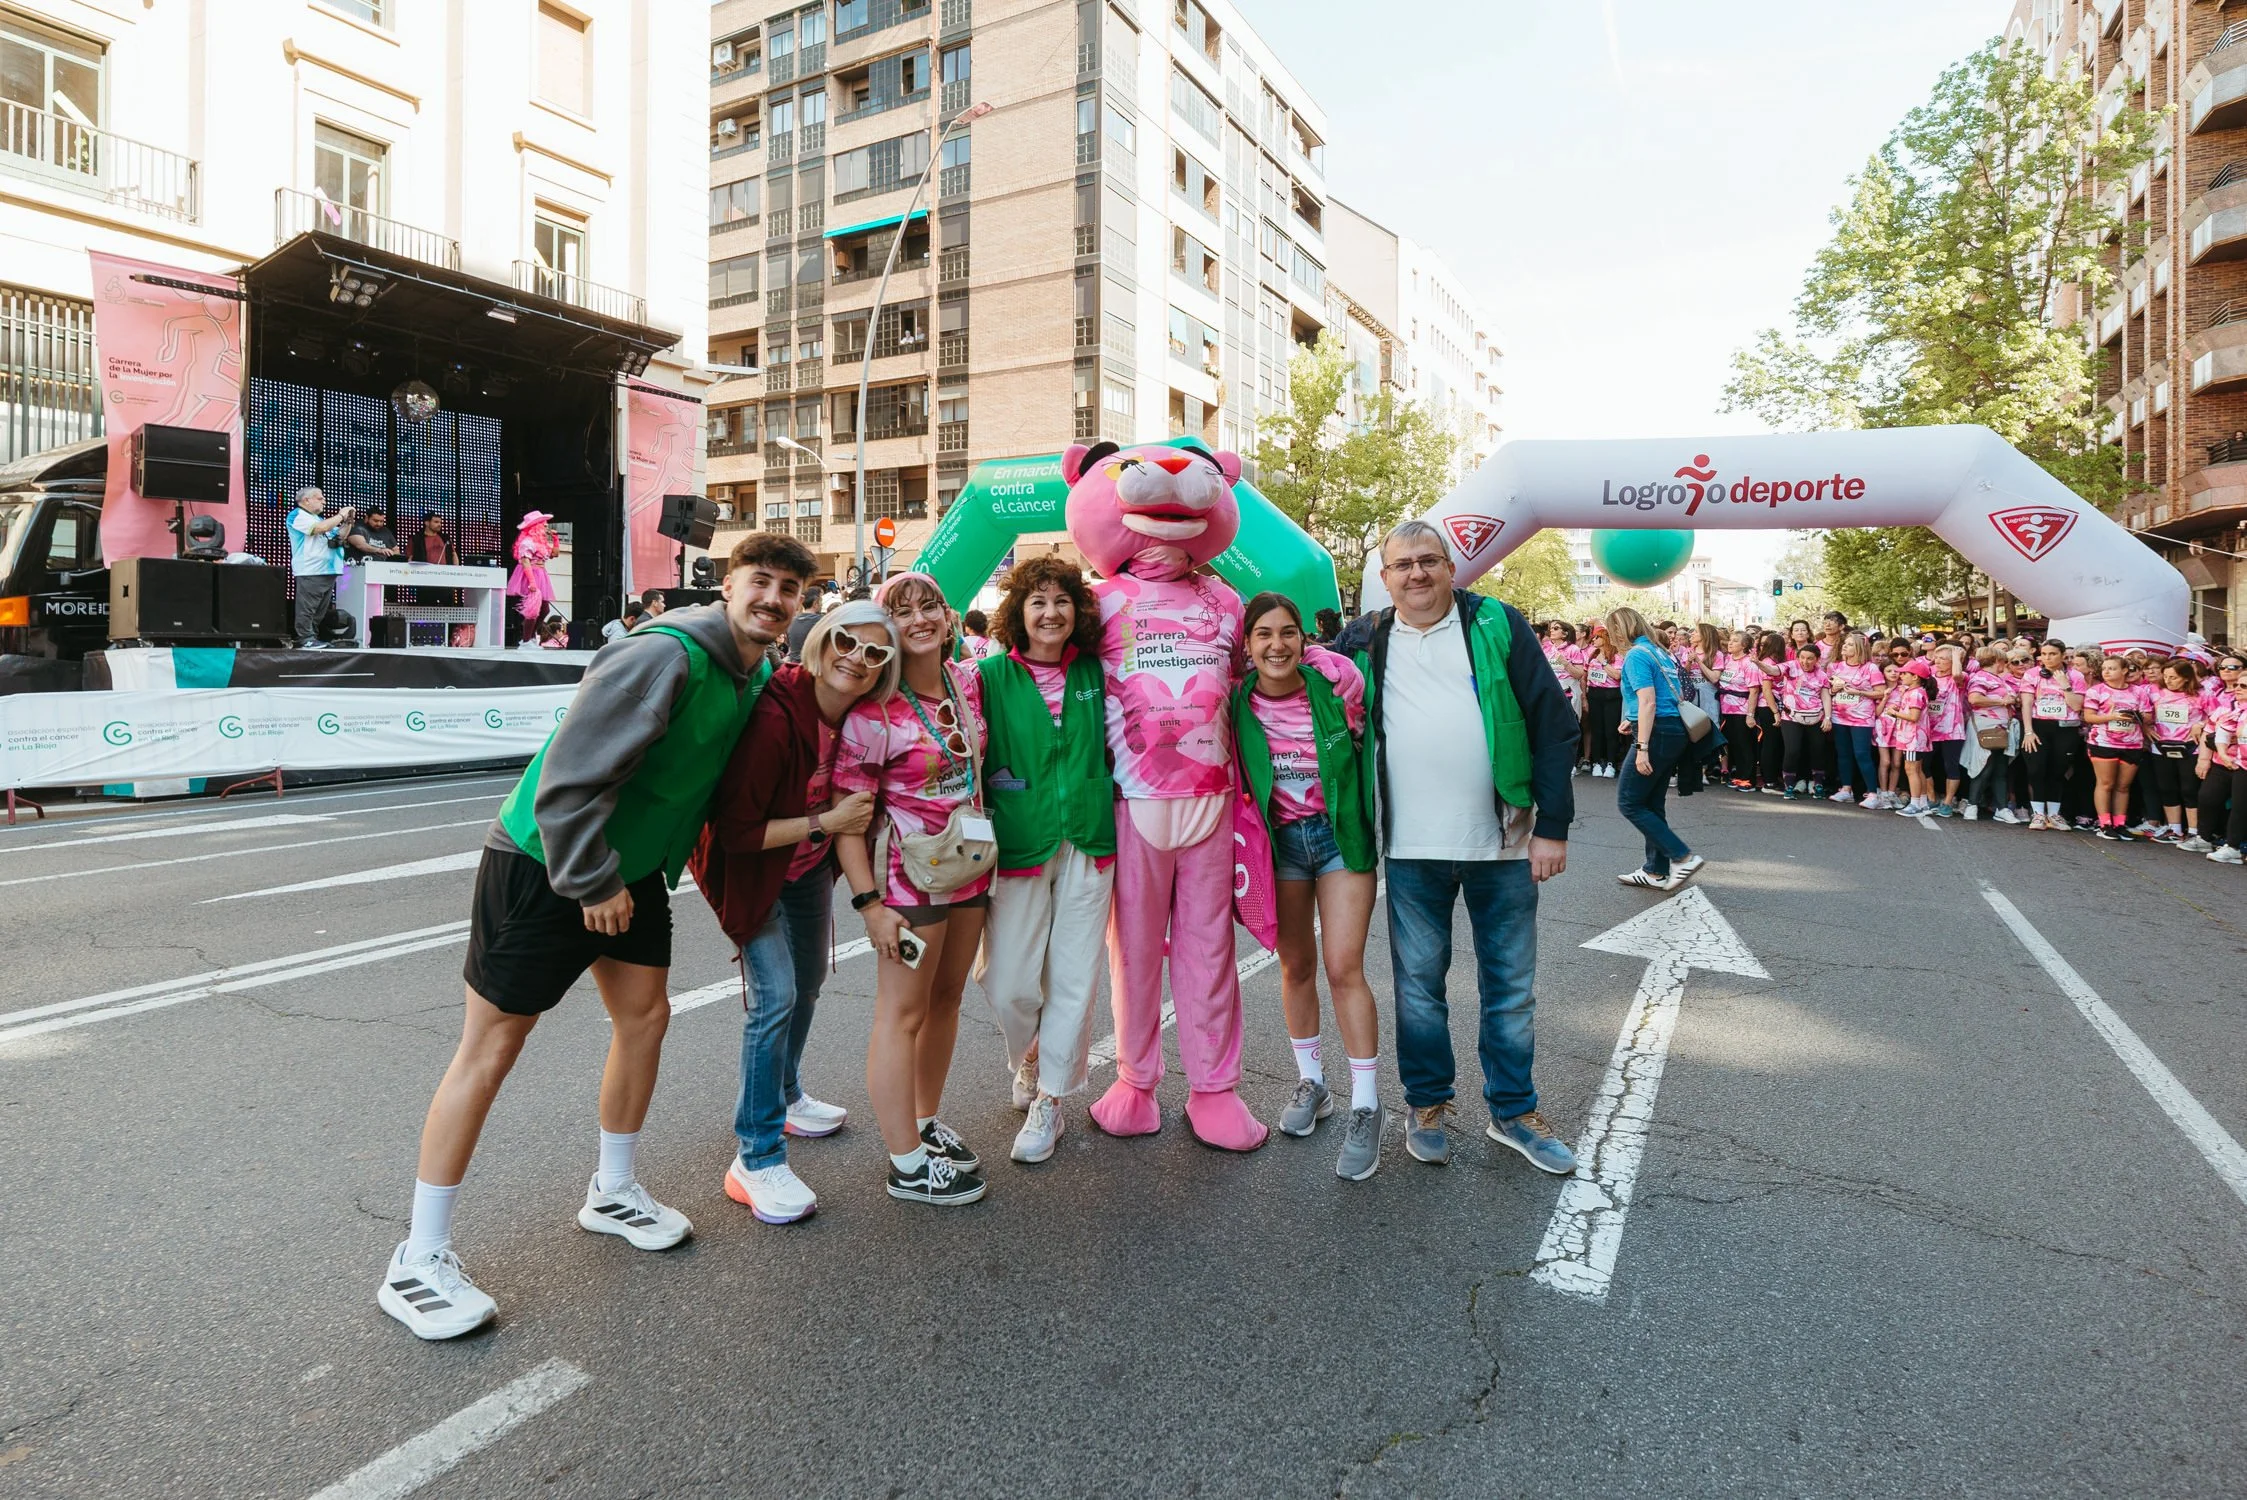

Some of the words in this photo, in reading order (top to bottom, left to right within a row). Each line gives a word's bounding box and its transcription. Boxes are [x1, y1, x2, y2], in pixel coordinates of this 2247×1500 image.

[109, 357, 141, 367] Carrera
[133, 368, 157, 376] Mujer
[994, 467, 1011, 480] En
[990, 481, 1035, 496] contra
[1730, 474, 1866, 508] deporte
[992, 499, 1007, 514] el
[1008, 498, 1056, 513] cáncer
[944, 532, 959, 548] Rioja
[1223, 550, 1243, 571] áncer
[1231, 545, 1262, 578] española
[1135, 619, 1148, 629] XI
[1135, 631, 1185, 641] Carrera
[1137, 645, 1158, 658] por
[1161, 643, 1173, 653] la
[1138, 654, 1220, 669] Investigación
[2165, 710, 2180, 719] 578
[8, 735, 38, 743] contra
[35, 742, 57, 750] Rioja
[1279, 763, 1291, 771] la
